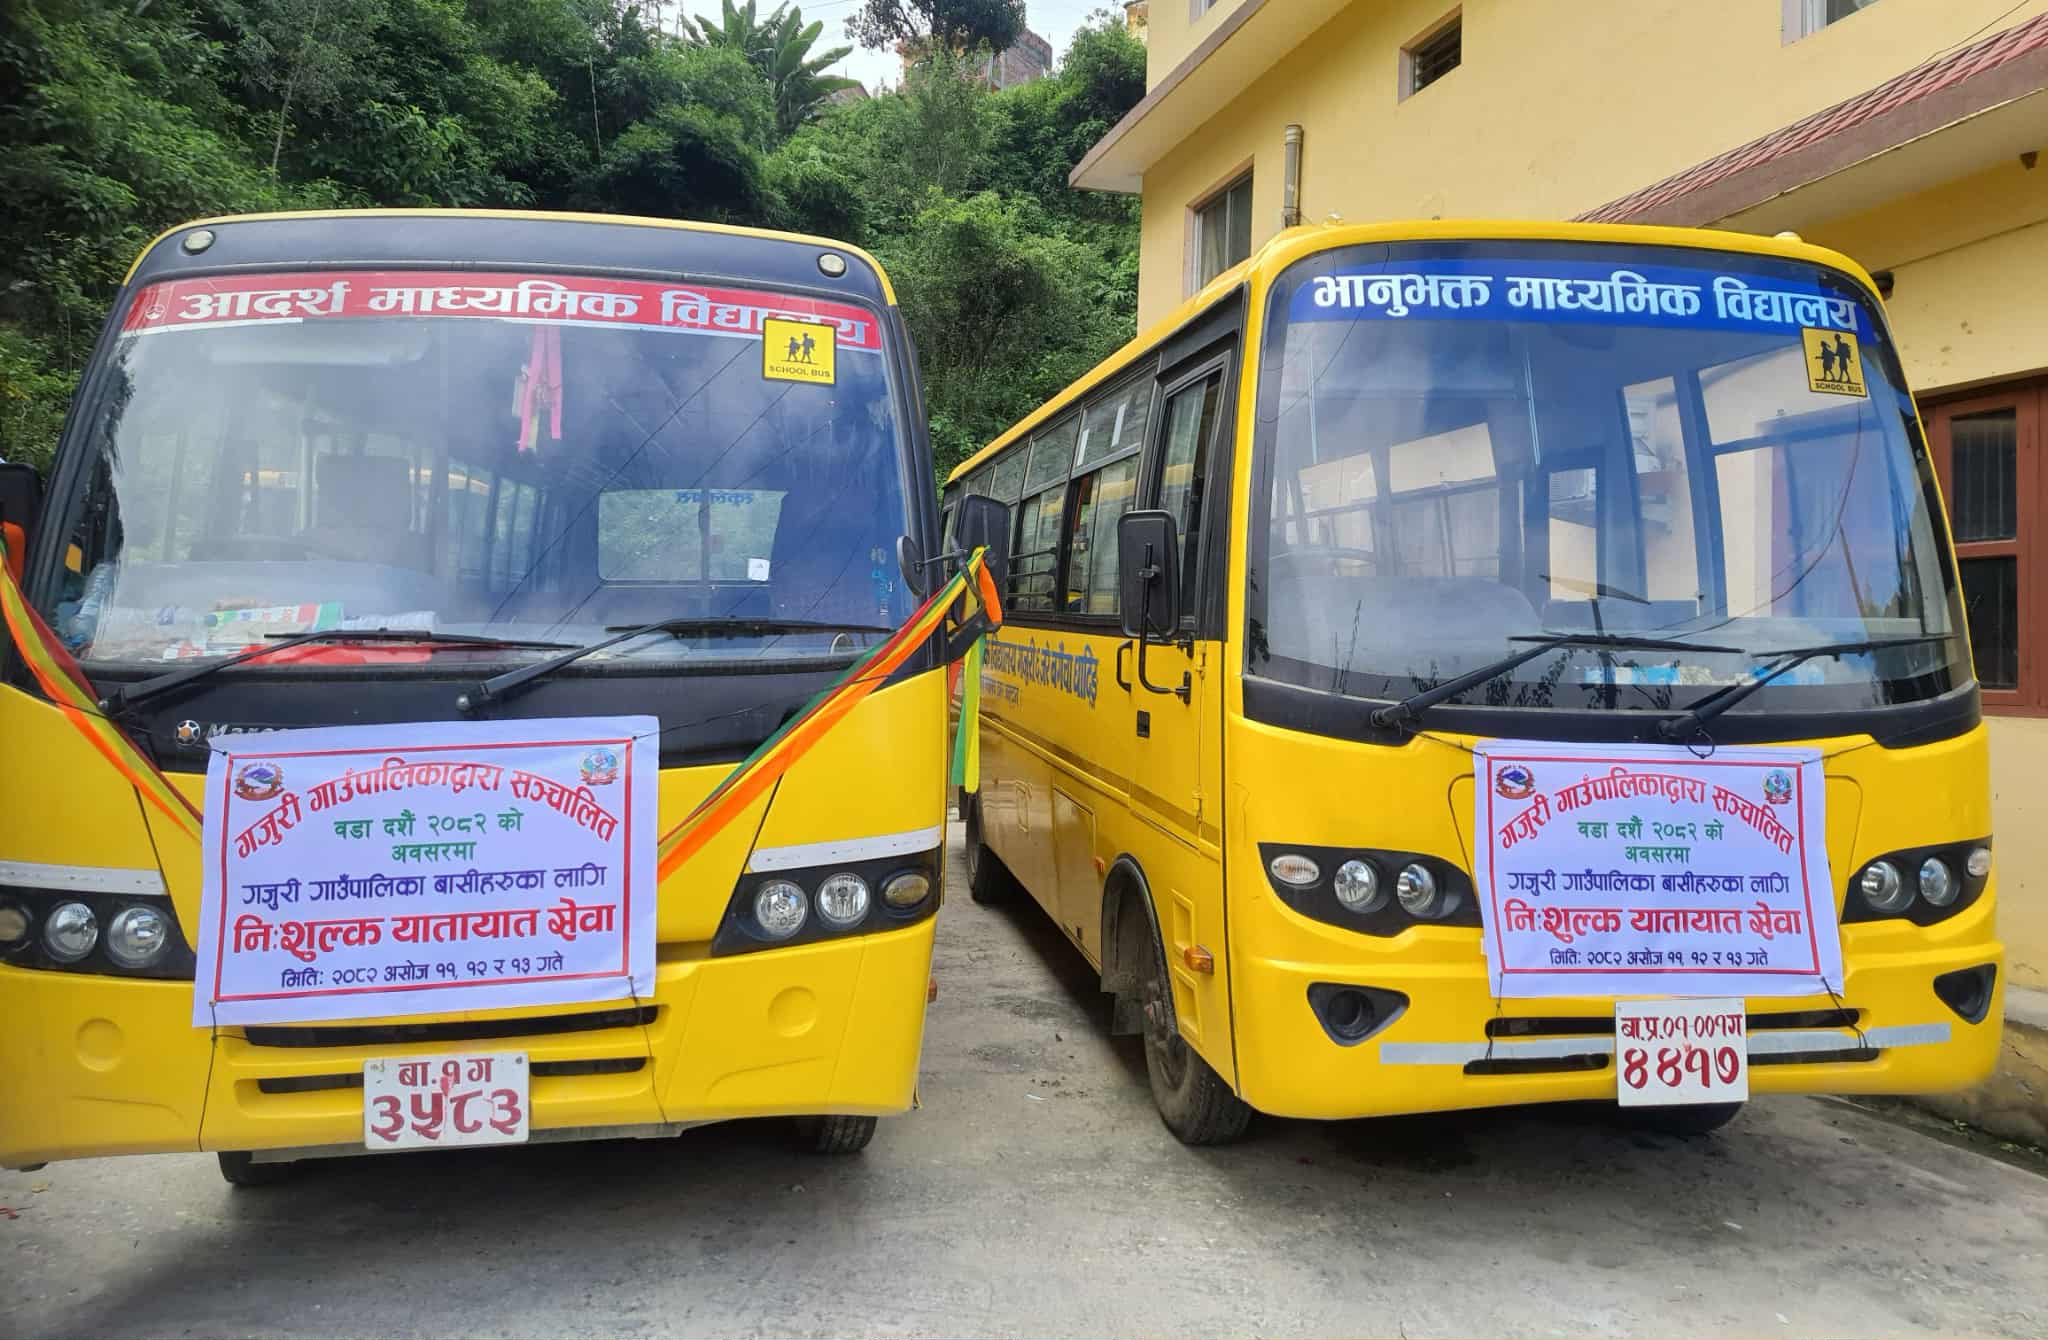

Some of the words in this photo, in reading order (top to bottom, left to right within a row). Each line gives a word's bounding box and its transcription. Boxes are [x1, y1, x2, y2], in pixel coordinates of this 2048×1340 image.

[178, 280, 352, 320] आदर्श
[368, 280, 643, 318] माध्यमिक
[661, 289, 870, 344] विद्याय
[1313, 273, 1493, 317] भानुभक्त
[1505, 270, 1701, 316] माध्यमिक
[1713, 276, 1858, 330] विद्यालय
[769, 365, 808, 376] SCHOOL
[811, 369, 830, 377] BUS
[1815, 383, 1846, 392] SCHOOL
[1848, 385, 1862, 393] BUS
[235, 792, 301, 859] गजुरी
[511, 770, 619, 842] सञ्चालित
[334, 819, 373, 839] वडा
[383, 809, 416, 837] दशैं
[428, 813, 487, 836] २०८२
[497, 806, 524, 832] को
[1498, 794, 1551, 849] गजुरी
[1712, 785, 1795, 855] सञ्चालित
[1577, 821, 1608, 839] वडा
[1616, 815, 1643, 840] दशैं
[1652, 821, 1697, 842] २०८२
[1704, 819, 1724, 841] को
[392, 841, 477, 863] अवसरमा
[1625, 846, 1691, 864] अवसरमा
[242, 877, 302, 911] गजुरी
[309, 873, 426, 901] गाउँपालिका
[554, 862, 607, 888] लागि
[1506, 869, 1557, 897] गजुरी
[1561, 868, 1656, 892] गाउँपालिका
[1749, 871, 1790, 894] लागि
[391, 909, 540, 943] यातायात
[547, 897, 616, 942] सेवा
[1628, 908, 1743, 934] यातायात
[1747, 901, 1801, 940] सेवा
[332, 967, 378, 985] २०८२
[384, 960, 430, 982] असोज
[466, 960, 488, 976] १२
[494, 959, 505, 975] र
[511, 957, 530, 974] १३
[536, 950, 564, 972] गते
[1587, 951, 1622, 965] २०८२
[1627, 947, 1663, 965] असोज
[1691, 951, 1708, 965] १२
[1713, 951, 1722, 965] र
[1726, 951, 1742, 966] १३
[1746, 947, 1768, 966] गते
[1624, 1046, 1739, 1089] ४४१७
[371, 1088, 522, 1143] ३५८३
